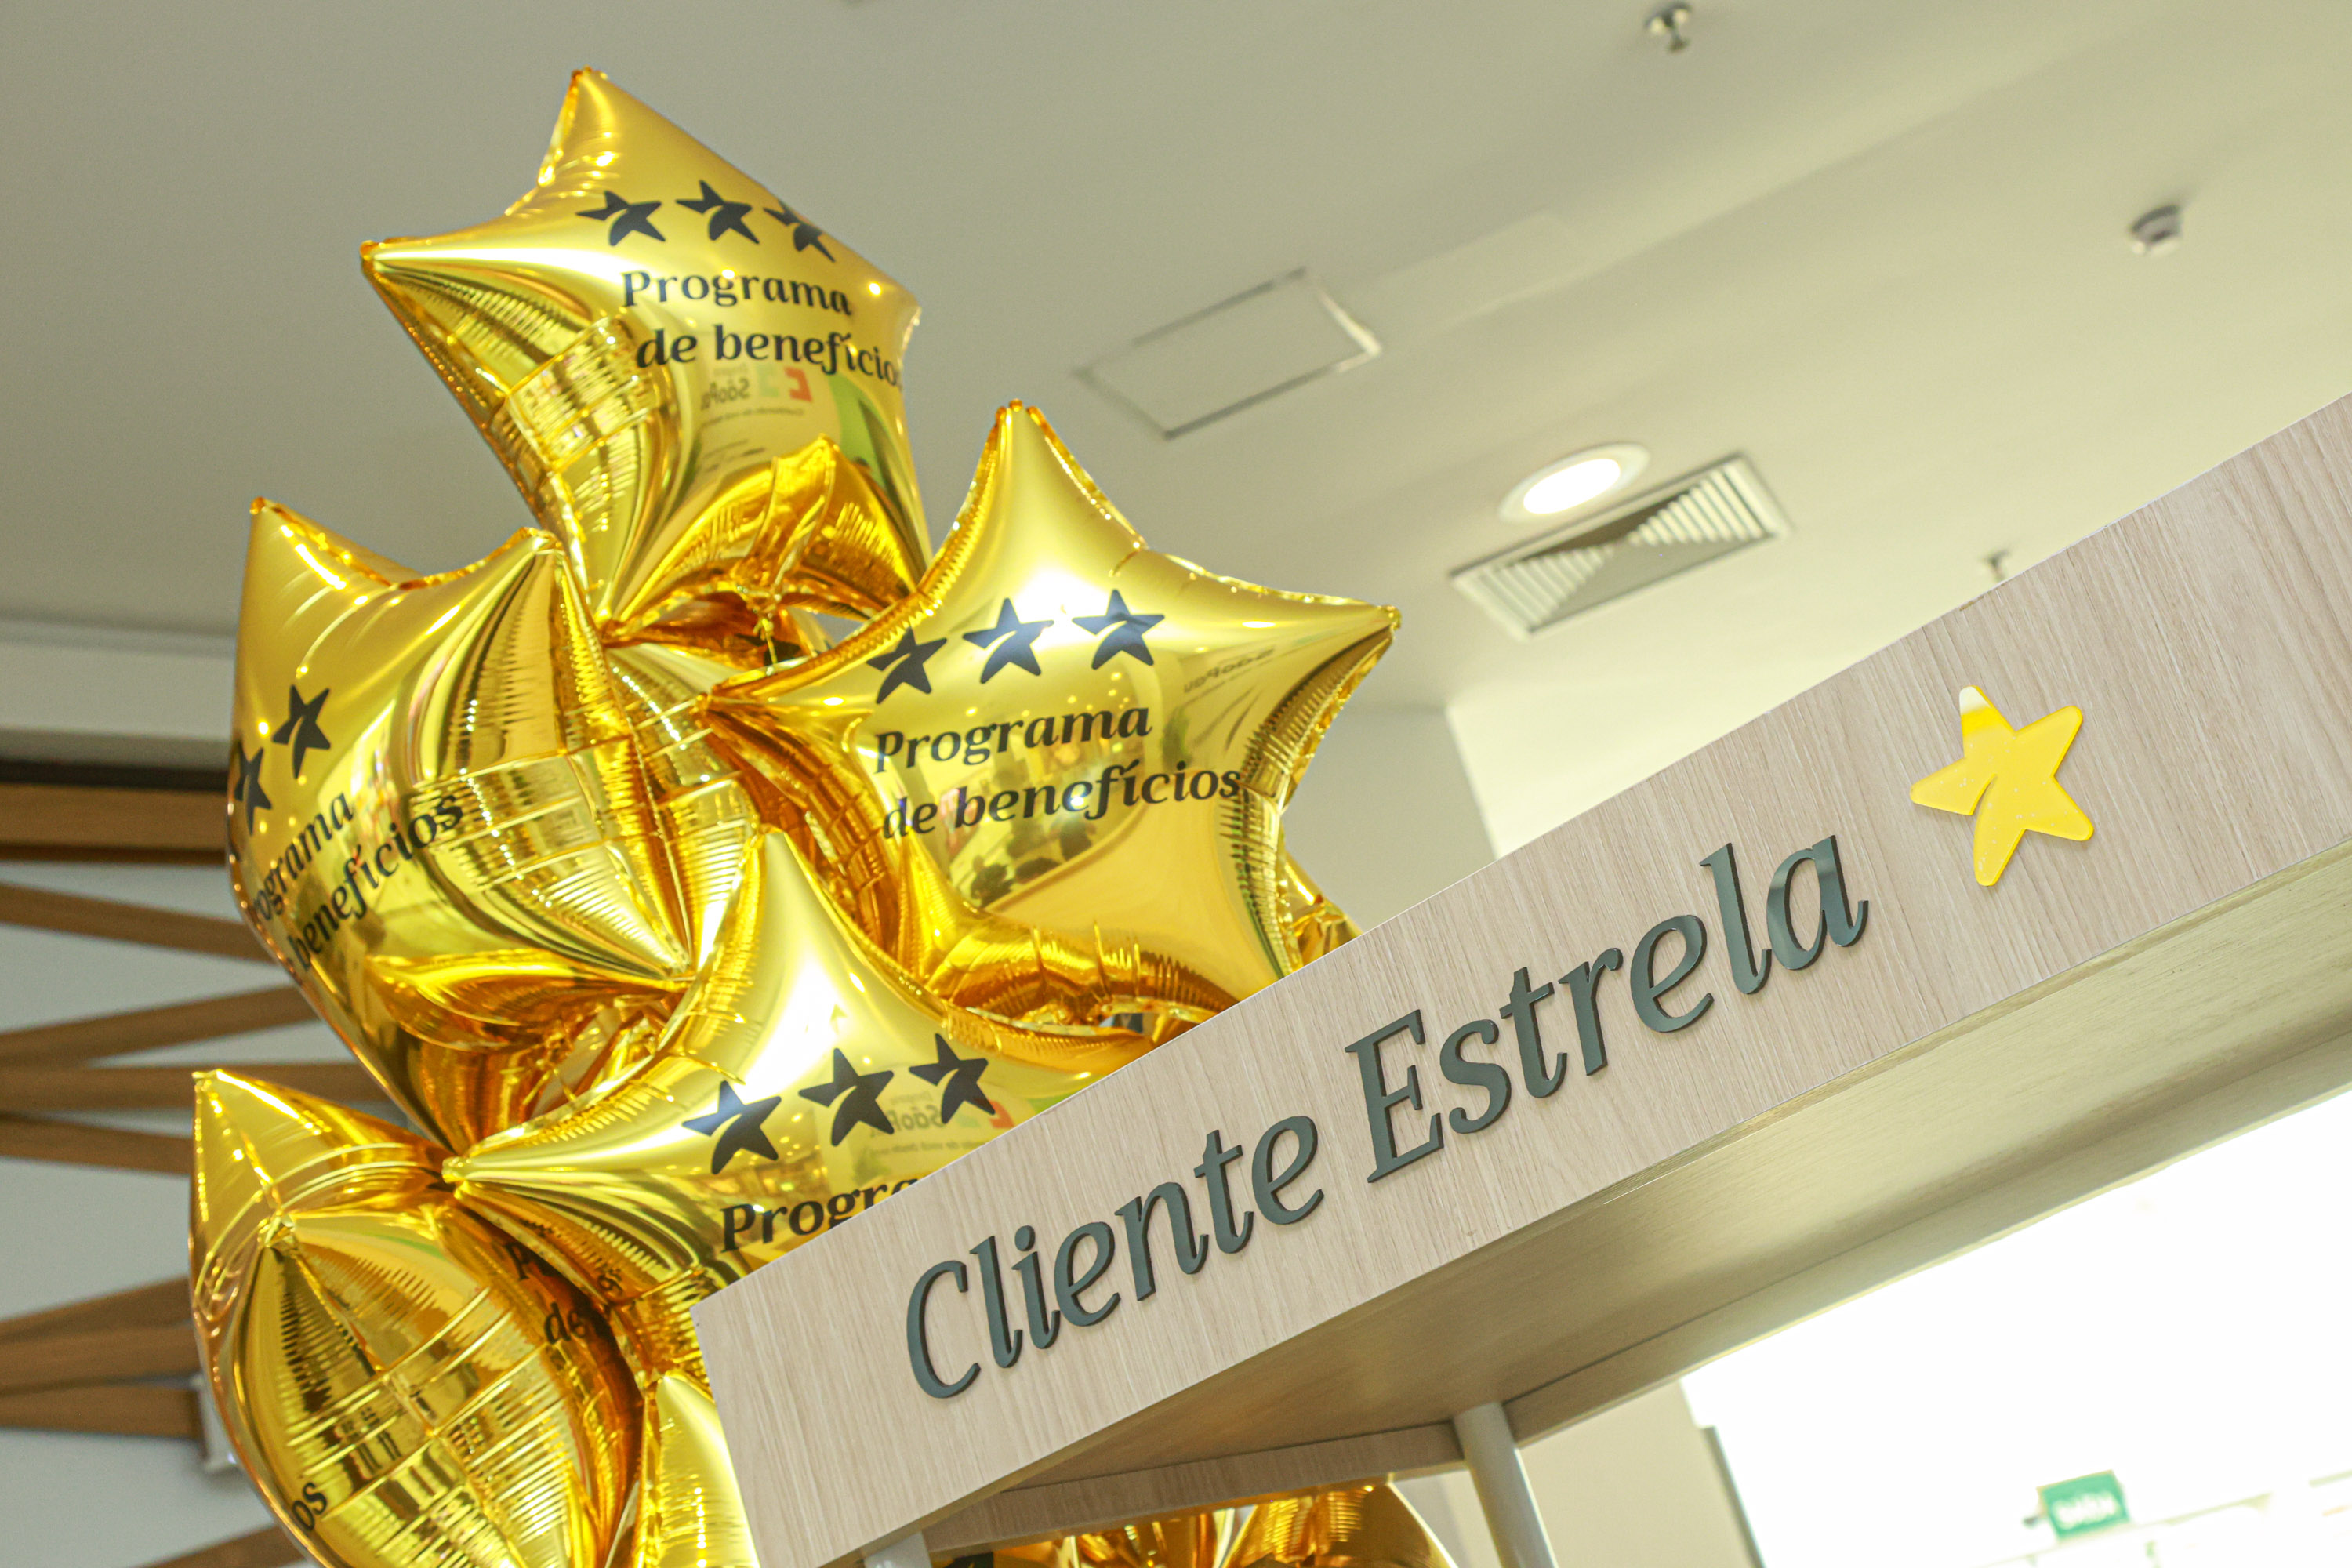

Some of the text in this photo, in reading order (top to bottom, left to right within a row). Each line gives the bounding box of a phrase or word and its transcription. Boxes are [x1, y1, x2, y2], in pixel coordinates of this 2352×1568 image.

[621, 270, 852, 316] Programa
[635, 323, 901, 390] de benefício
[873, 706, 1153, 775] Programa
[883, 758, 1242, 840] de benefícios
[906, 833, 1870, 1399] Cliente Estrela
